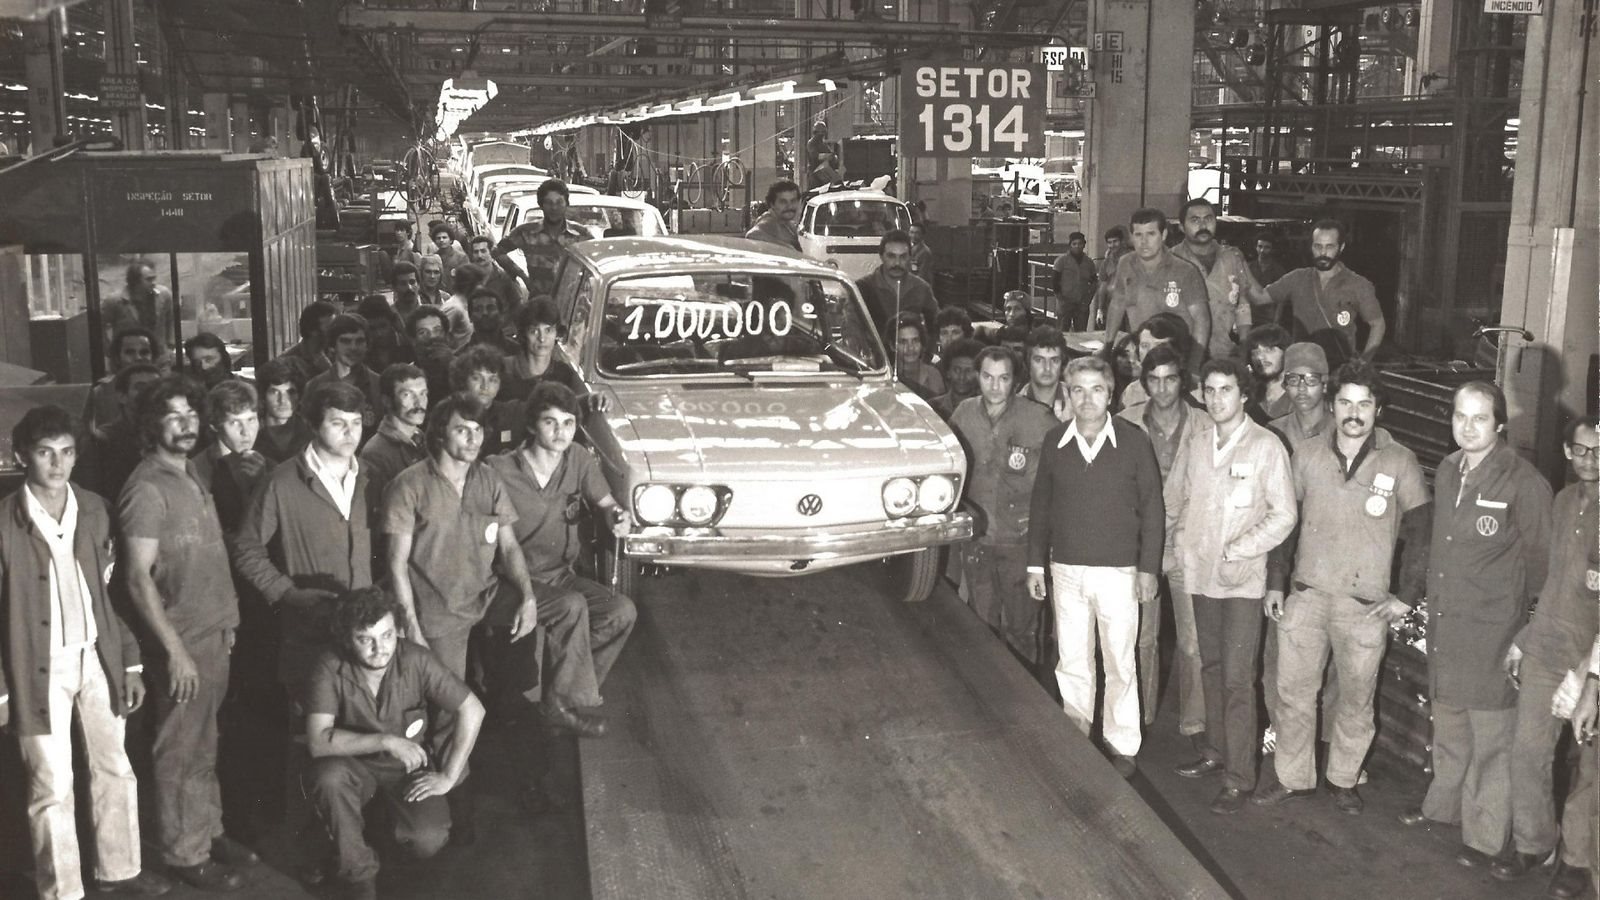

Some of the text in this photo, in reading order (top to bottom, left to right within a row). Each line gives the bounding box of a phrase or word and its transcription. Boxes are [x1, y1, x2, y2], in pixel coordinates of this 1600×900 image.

[1109, 34, 1119, 49] E
[1042, 51, 1087, 66] ESCDA
[916, 67, 1031, 98] SETOR
[1111, 70, 1123, 84] 15
[919, 104, 1028, 152] 1314
[126, 189, 213, 204] INSPEÇÃO SETOR
[1009, 453, 1026, 470] VW
[797, 494, 823, 516] VW
[1476, 515, 1499, 537] VW
